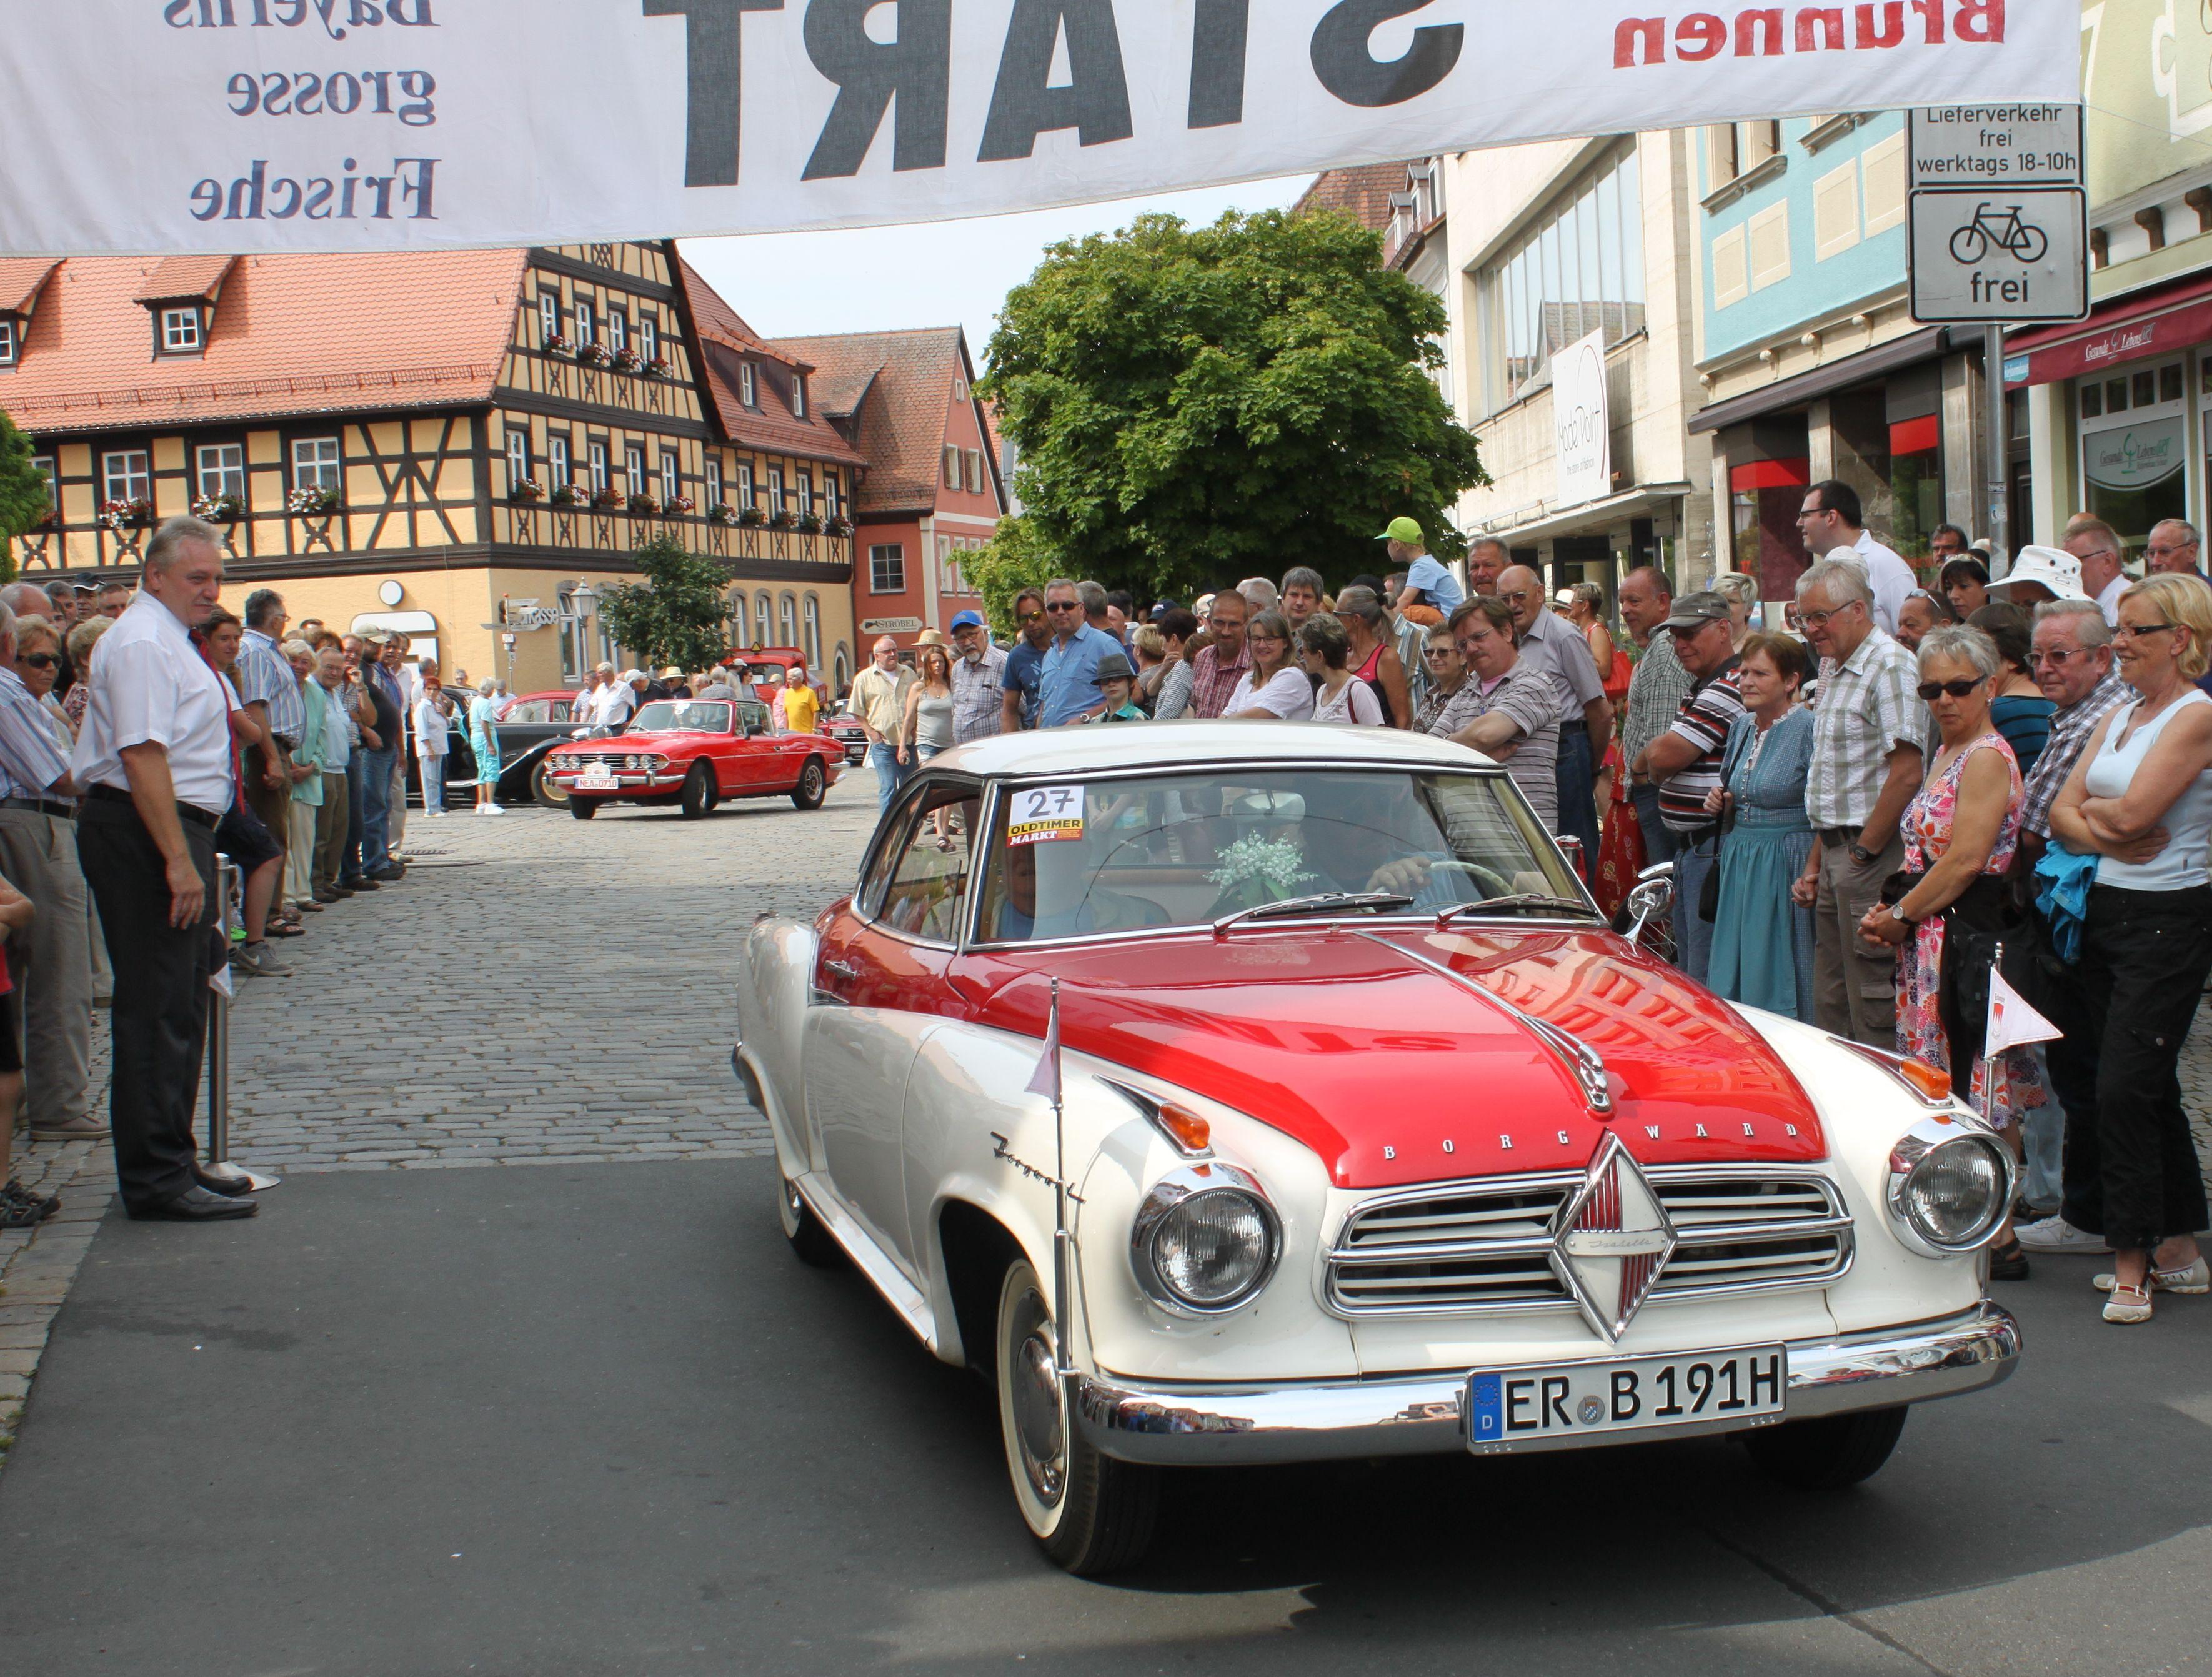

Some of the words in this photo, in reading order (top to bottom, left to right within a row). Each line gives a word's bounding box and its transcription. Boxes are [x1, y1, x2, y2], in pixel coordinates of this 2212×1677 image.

[1927, 104, 2062, 124] Lieferverkehr
[1980, 129, 2012, 147] frei
[1917, 154, 2010, 176] werktags
[2017, 152, 2076, 171] 18-10h
[1970, 271, 2028, 303] frei
[1558, 410, 1578, 462] Mode
[1027, 789, 1075, 818] 27
[1010, 820, 1080, 834] OLDTIMER
[1010, 830, 1057, 845] MARKT
[1383, 1123, 1798, 1160] BORGWARD
[1482, 1415, 1493, 1430] D
[1505, 1376, 1572, 1431] ER
